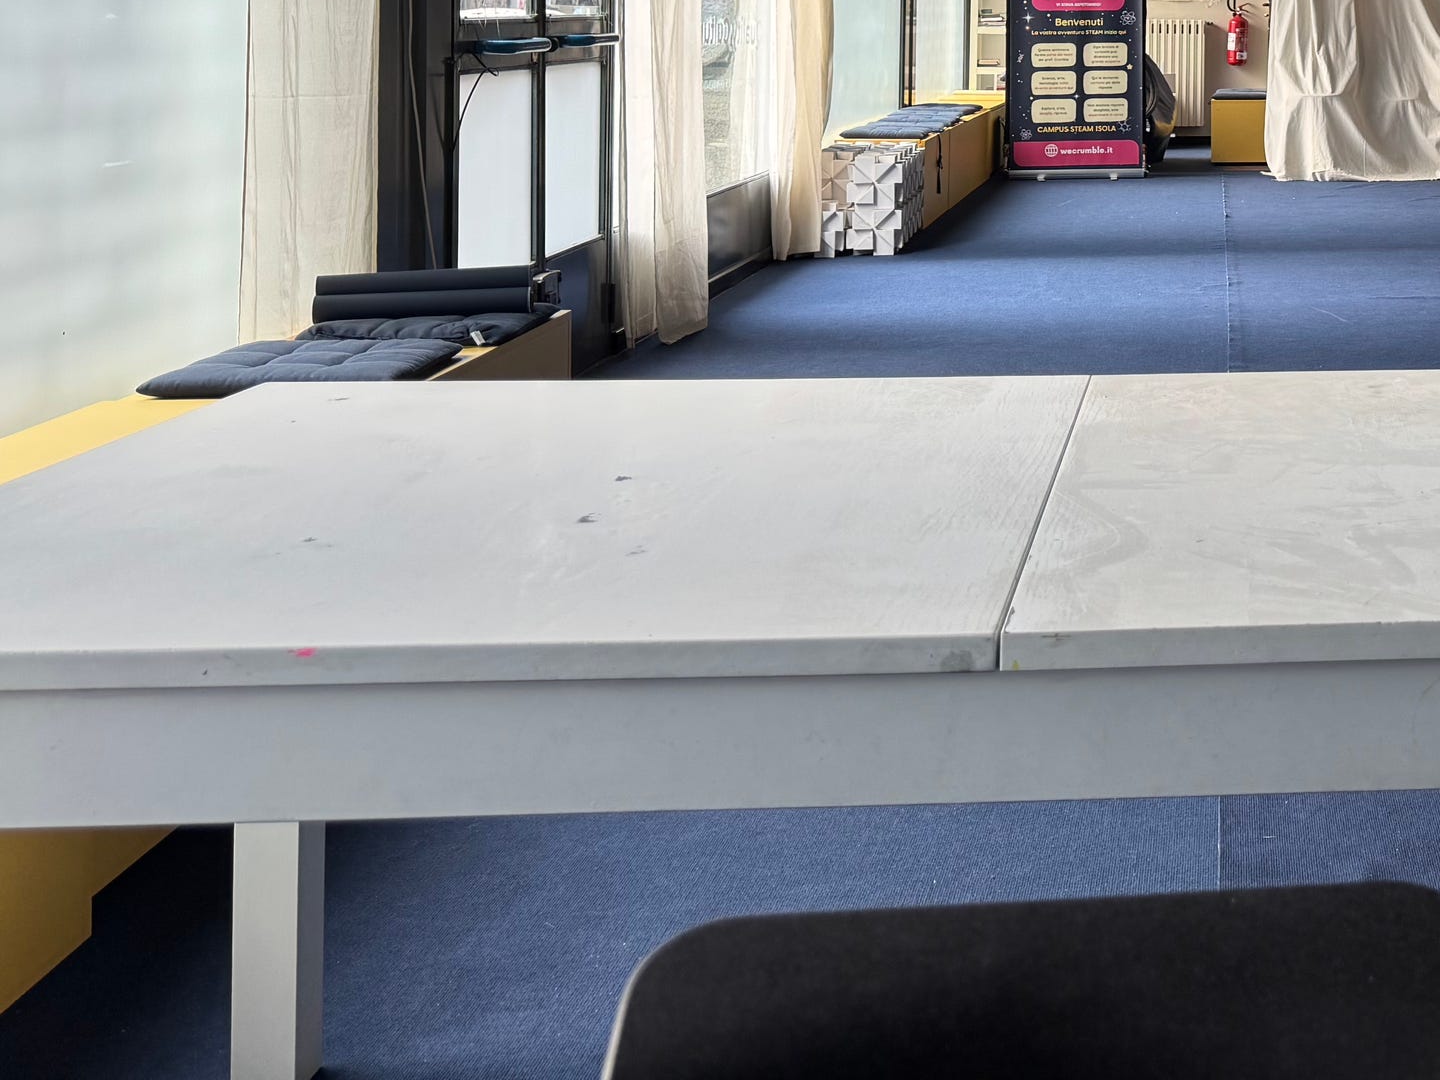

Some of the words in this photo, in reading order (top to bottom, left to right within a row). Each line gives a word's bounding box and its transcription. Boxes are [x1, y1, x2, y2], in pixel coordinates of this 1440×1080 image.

[1055, 17, 1104, 27] Benvenuti
[1070, 125, 1094, 133] STEAM
[1060, 145, 1113, 155] wecrumble.it
